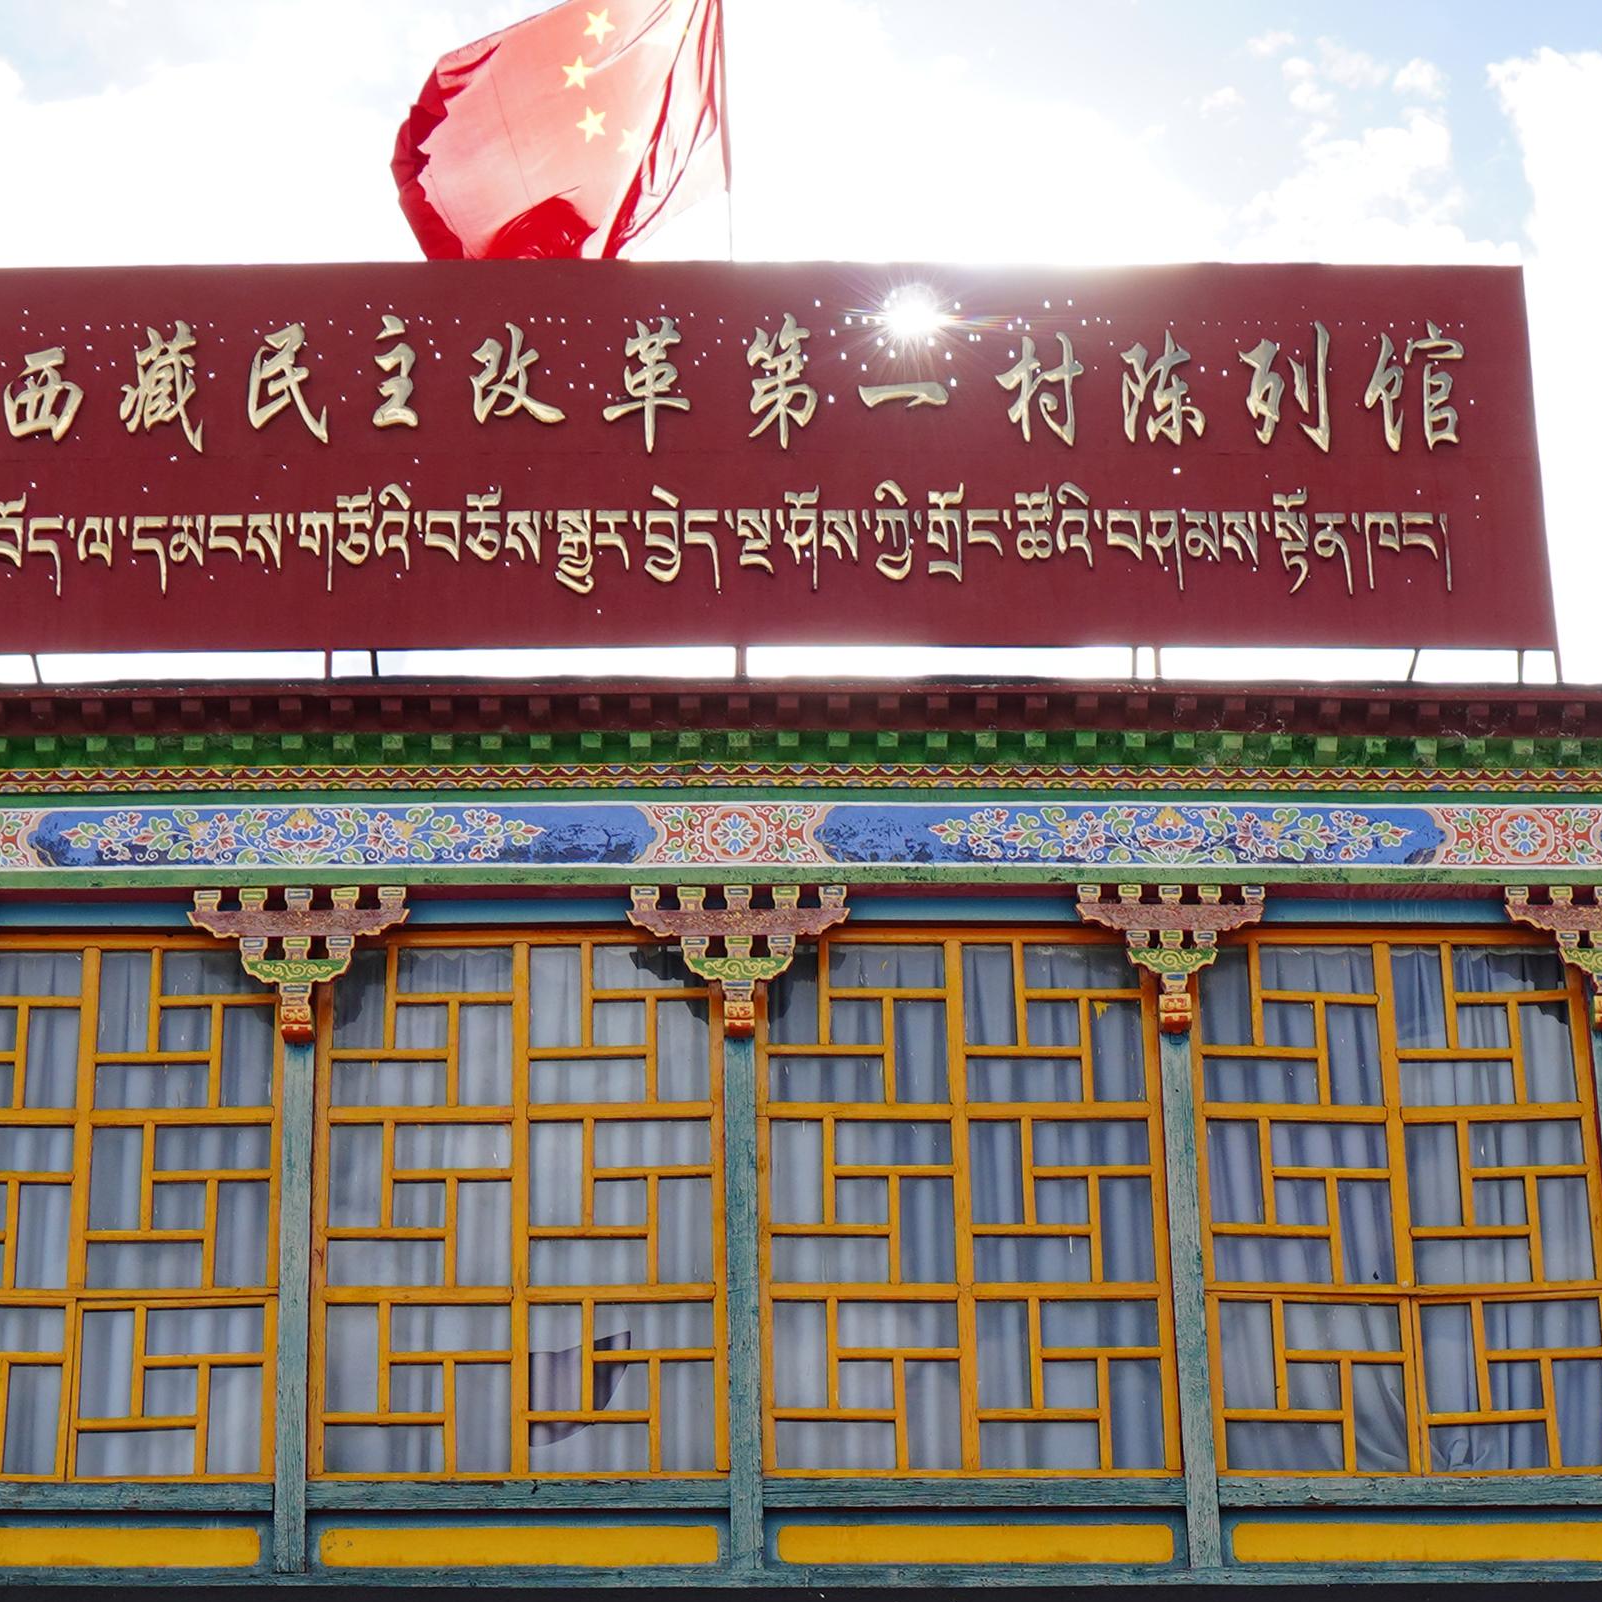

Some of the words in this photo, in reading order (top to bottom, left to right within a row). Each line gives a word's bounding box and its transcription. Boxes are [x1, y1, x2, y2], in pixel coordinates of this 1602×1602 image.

[1, 313, 1467, 453] 西藏民主改革第一村陈列馆
